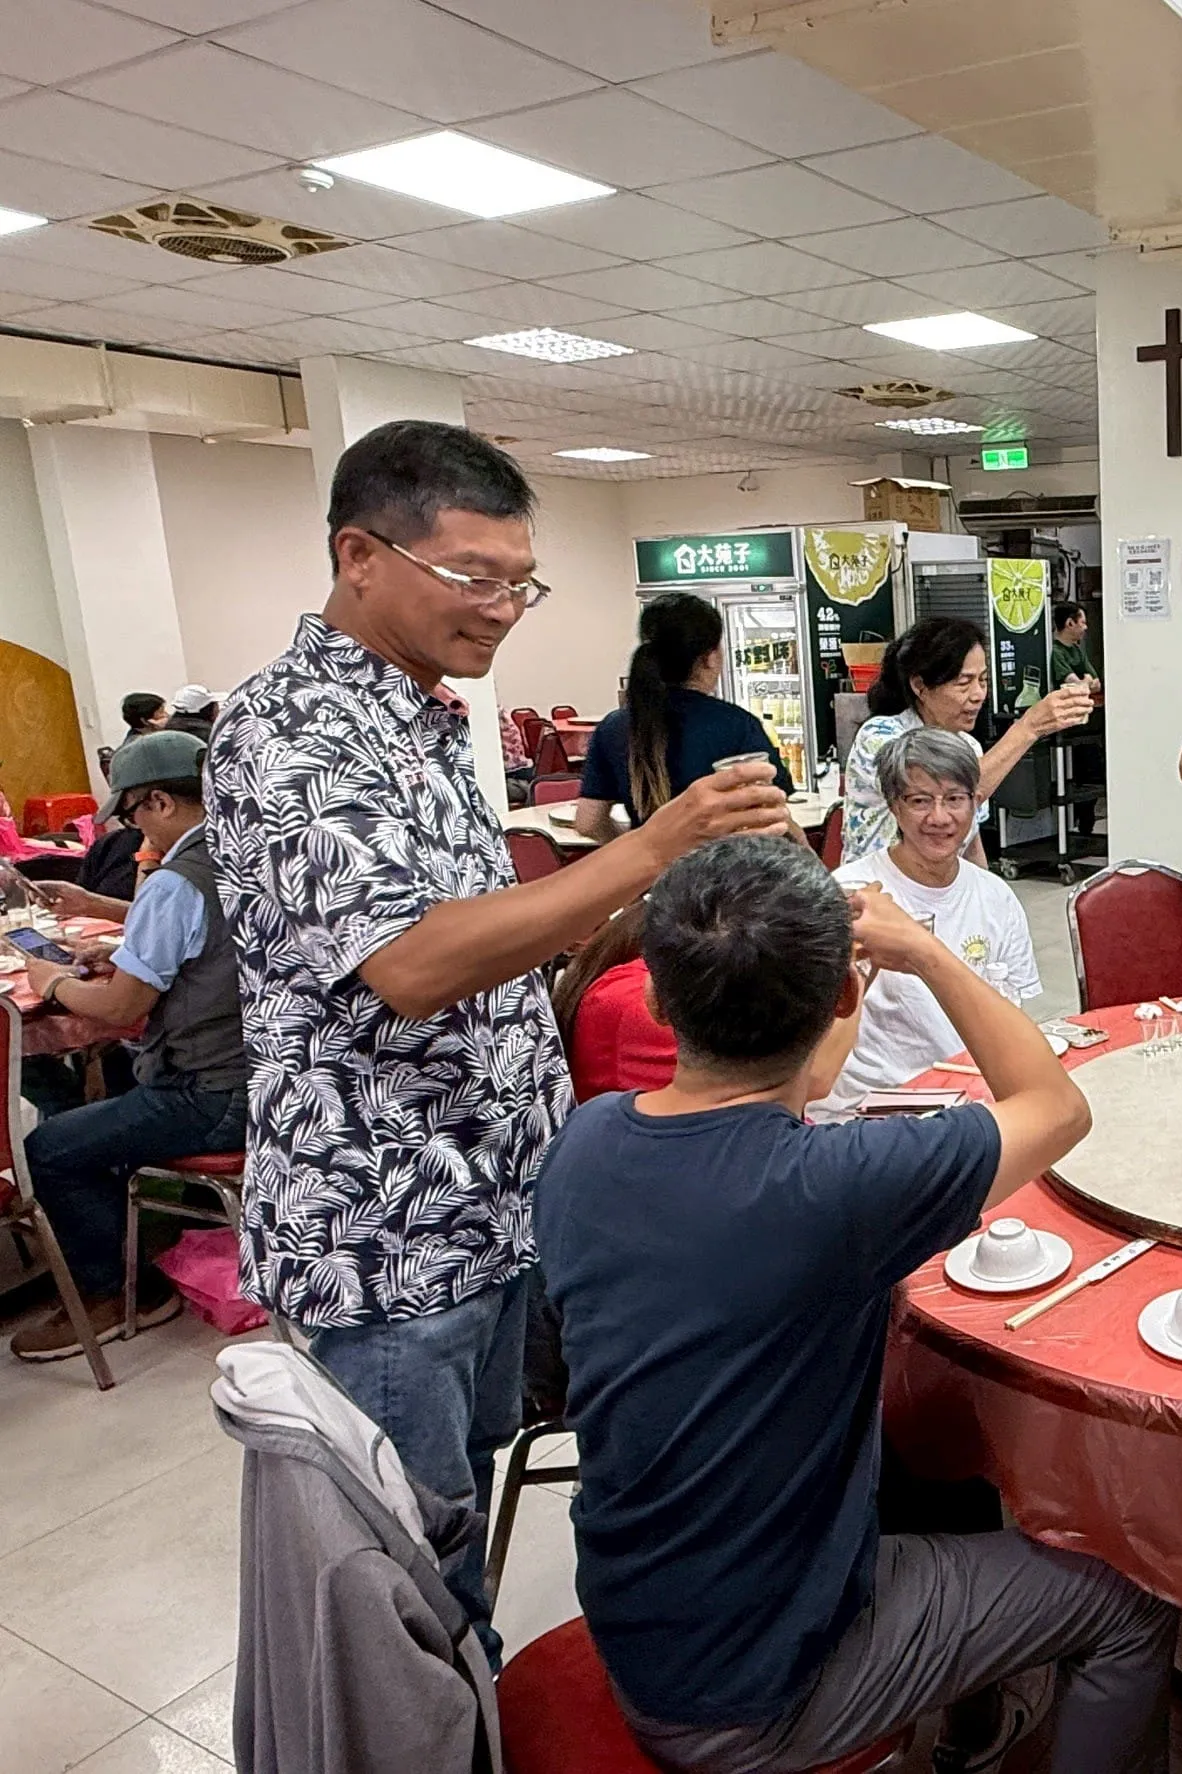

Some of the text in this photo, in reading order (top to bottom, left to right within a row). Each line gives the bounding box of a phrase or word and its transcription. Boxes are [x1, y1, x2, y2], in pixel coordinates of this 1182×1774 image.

[697, 543, 750, 566] 大苑子
[701, 565, 725, 573] SINCE
